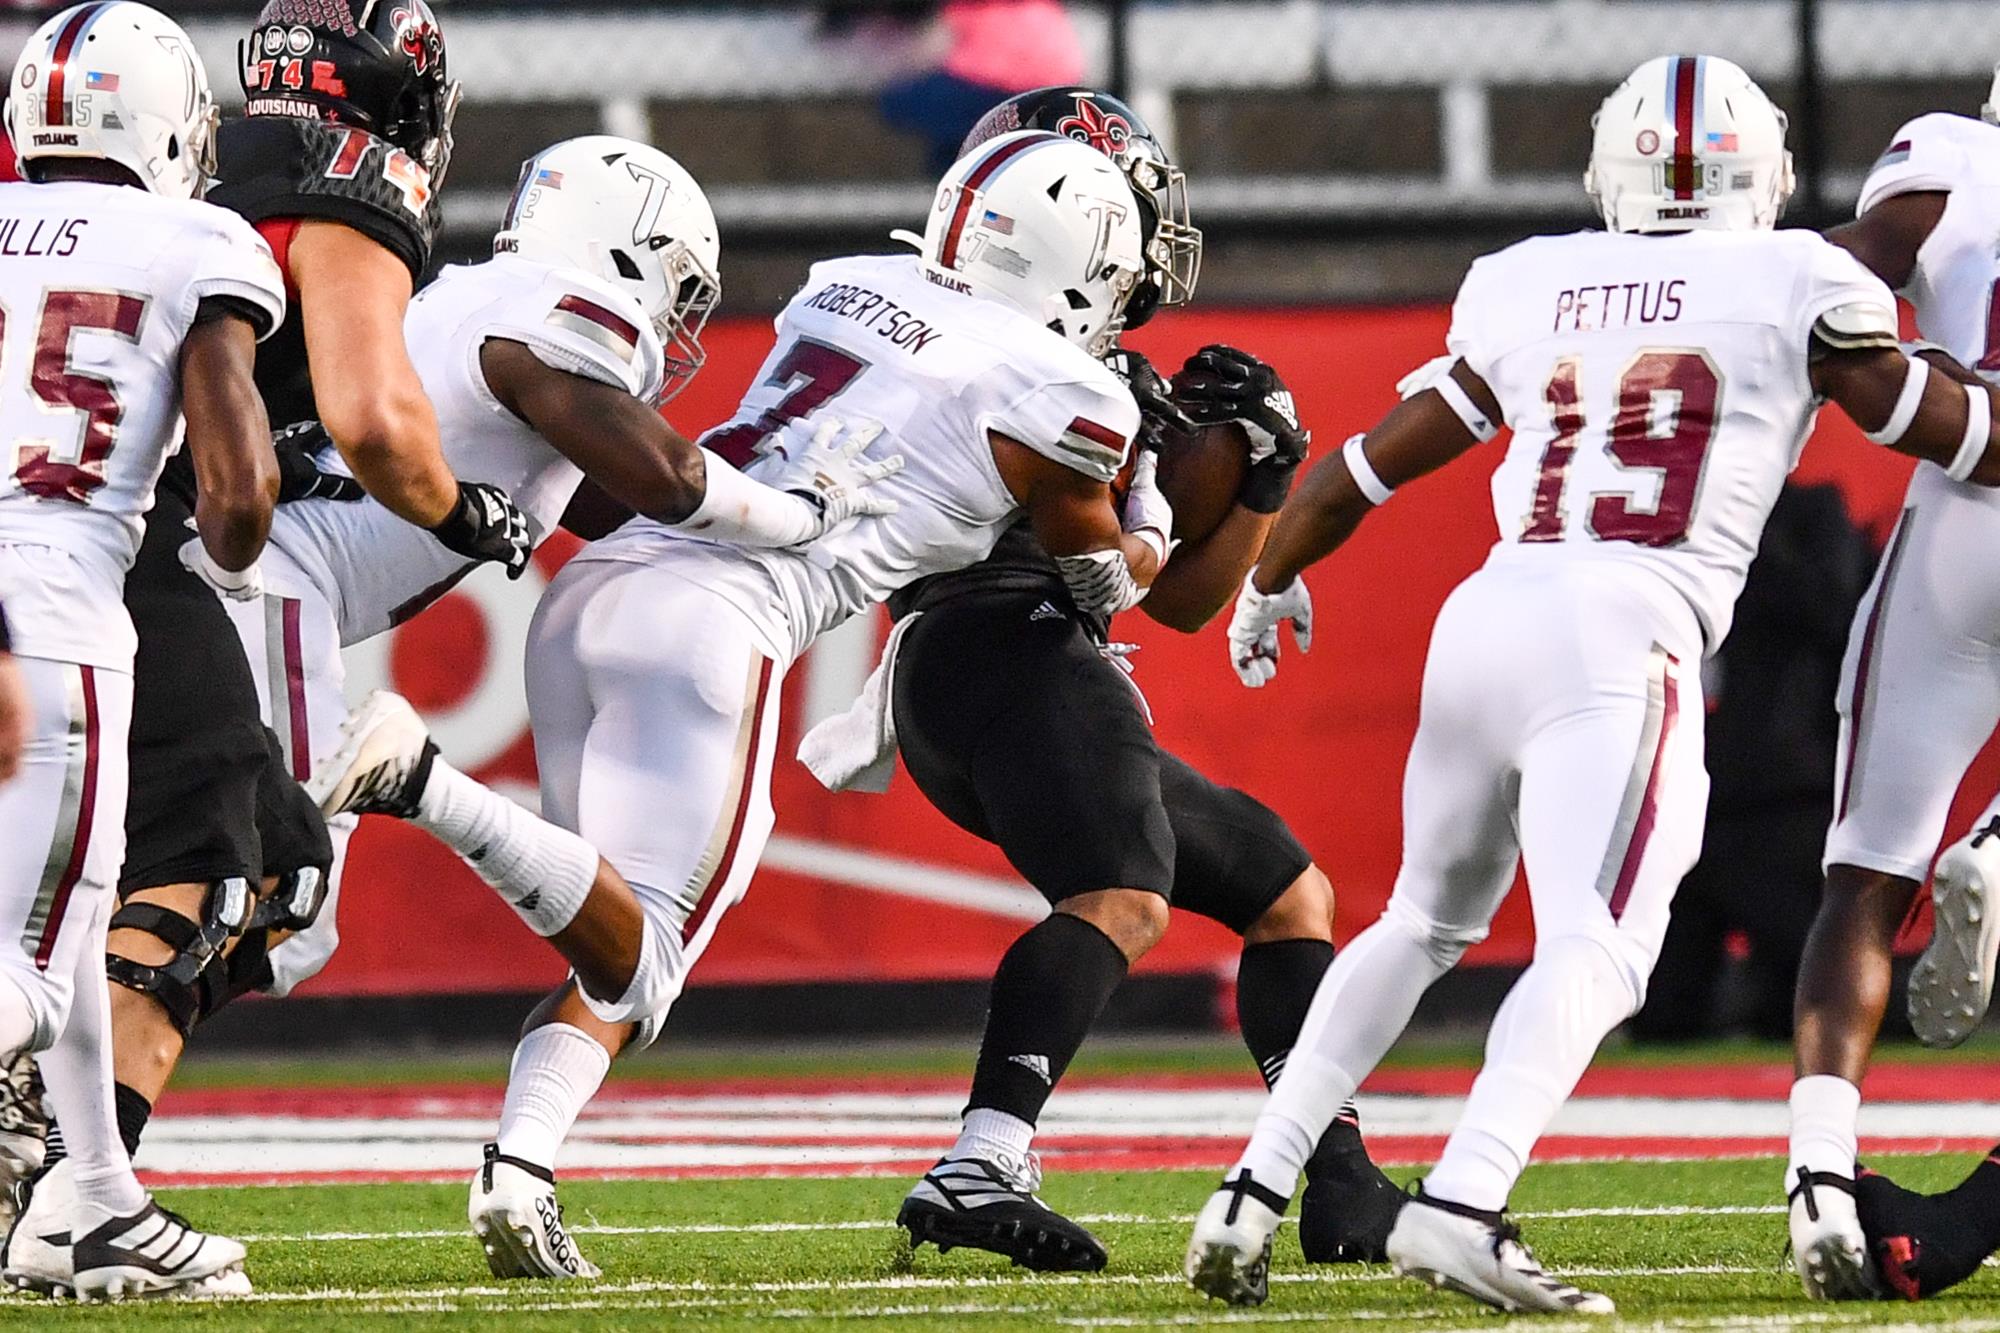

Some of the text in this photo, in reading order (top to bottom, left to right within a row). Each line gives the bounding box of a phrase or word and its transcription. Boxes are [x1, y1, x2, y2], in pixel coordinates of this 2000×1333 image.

[258, 58, 304, 92] 74
[247, 99, 322, 120] LOUISIANA
[32, 133, 80, 147] TROJANS
[1656, 206, 1711, 221] TROJANS
[0, 218, 89, 256] ILLIS
[803, 282, 943, 356] ROBERTSON
[1553, 279, 1687, 333] PETTUS
[696, 333, 874, 473] 7
[1517, 345, 1726, 548] 19
[535, 1196, 580, 1275] adidas
